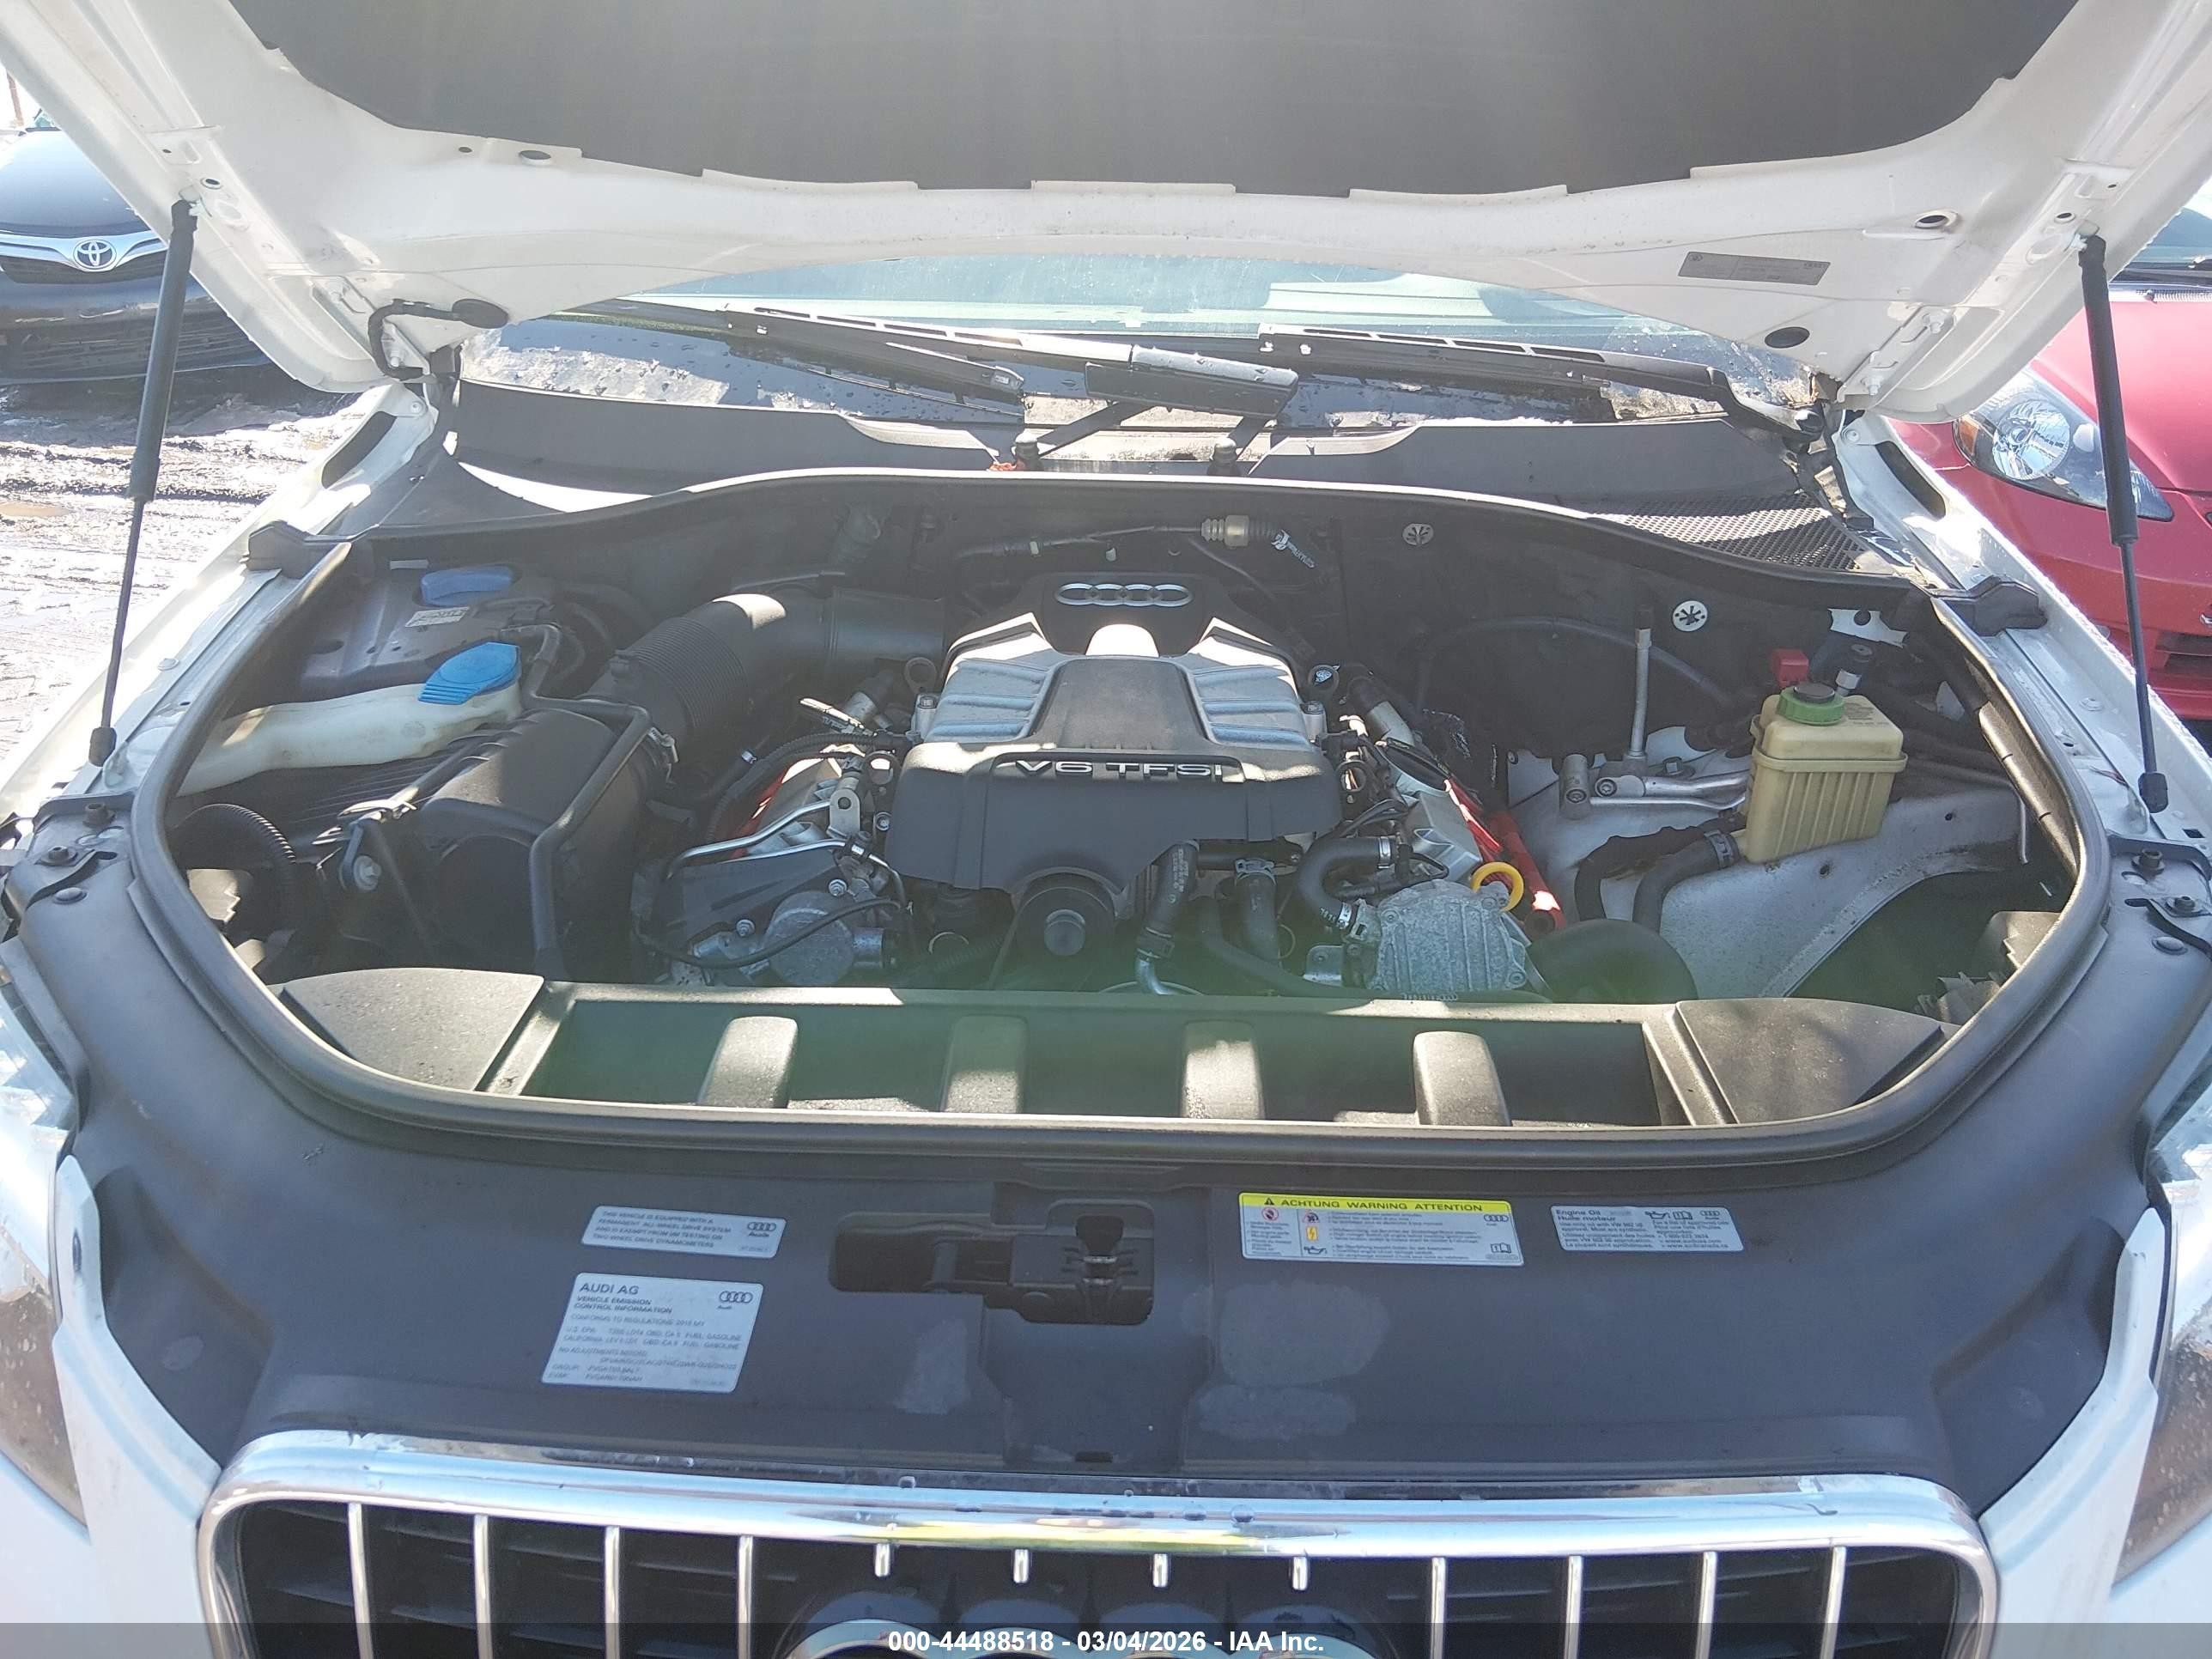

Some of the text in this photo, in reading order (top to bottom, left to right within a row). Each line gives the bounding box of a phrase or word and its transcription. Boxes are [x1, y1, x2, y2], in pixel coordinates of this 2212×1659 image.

[1016, 760, 1222, 777] V6 TFSI
[1280, 1199, 1483, 1212] ACHTUNG WARNING ATTENTION
[579, 1283, 640, 1295] AUDI AG
[614, 1305, 673, 1314] INFORMATION
